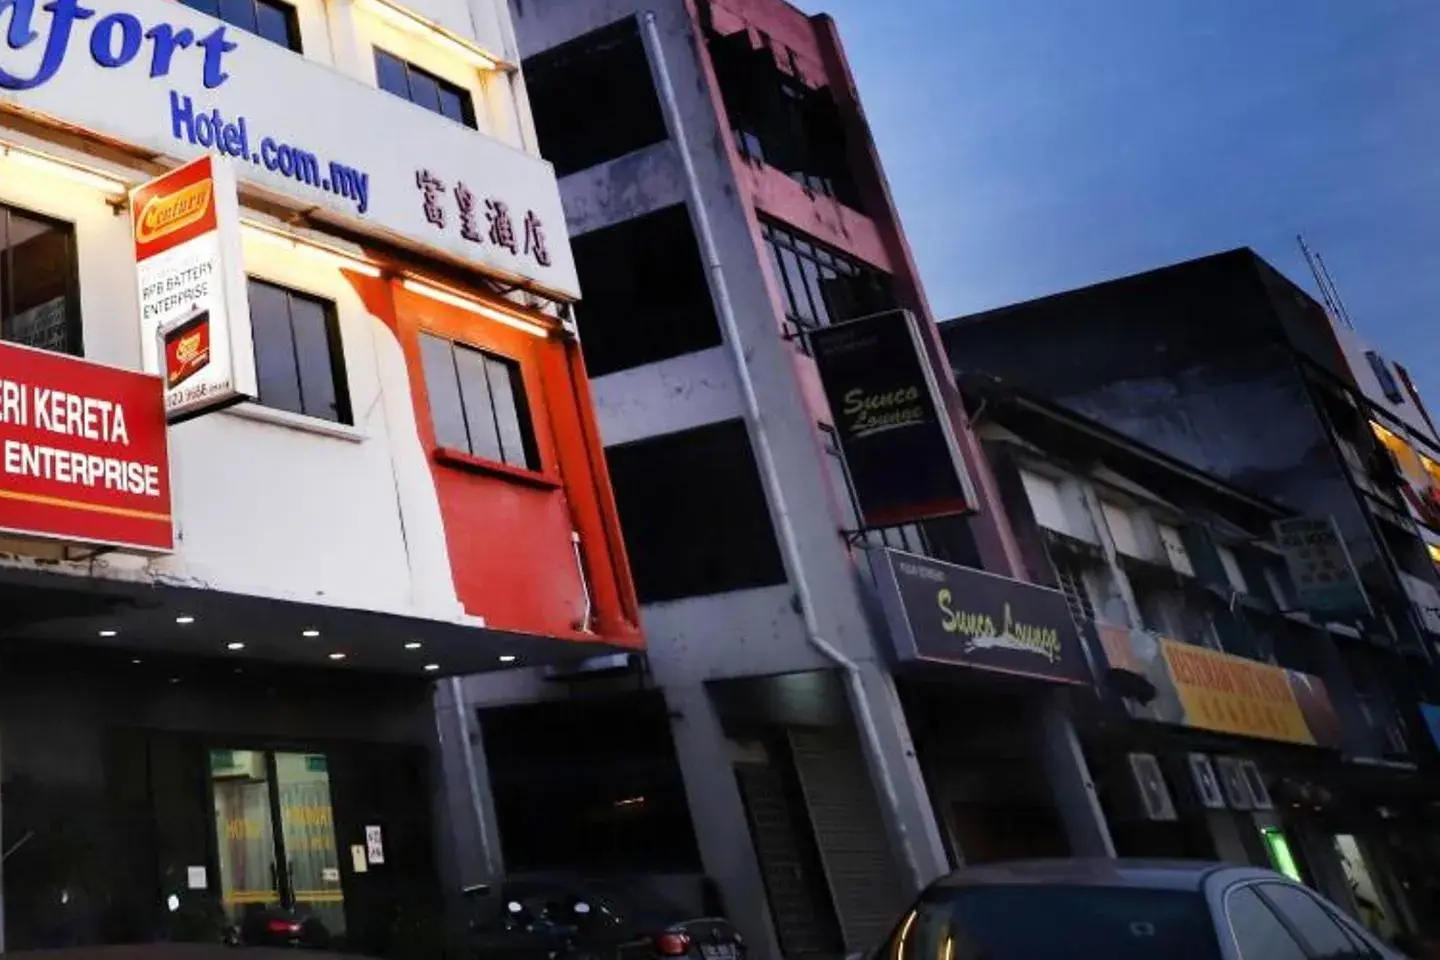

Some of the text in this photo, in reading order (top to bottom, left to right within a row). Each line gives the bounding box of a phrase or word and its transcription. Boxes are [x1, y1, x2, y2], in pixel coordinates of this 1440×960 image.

[169, 91, 371, 213] Hotel.com.my
[143, 281, 208, 320] ENTERPRISE
[166, 261, 213, 291] BATTERY
[33, 387, 129, 445] KERETA
[5, 440, 160, 497] ENTERPRISE
